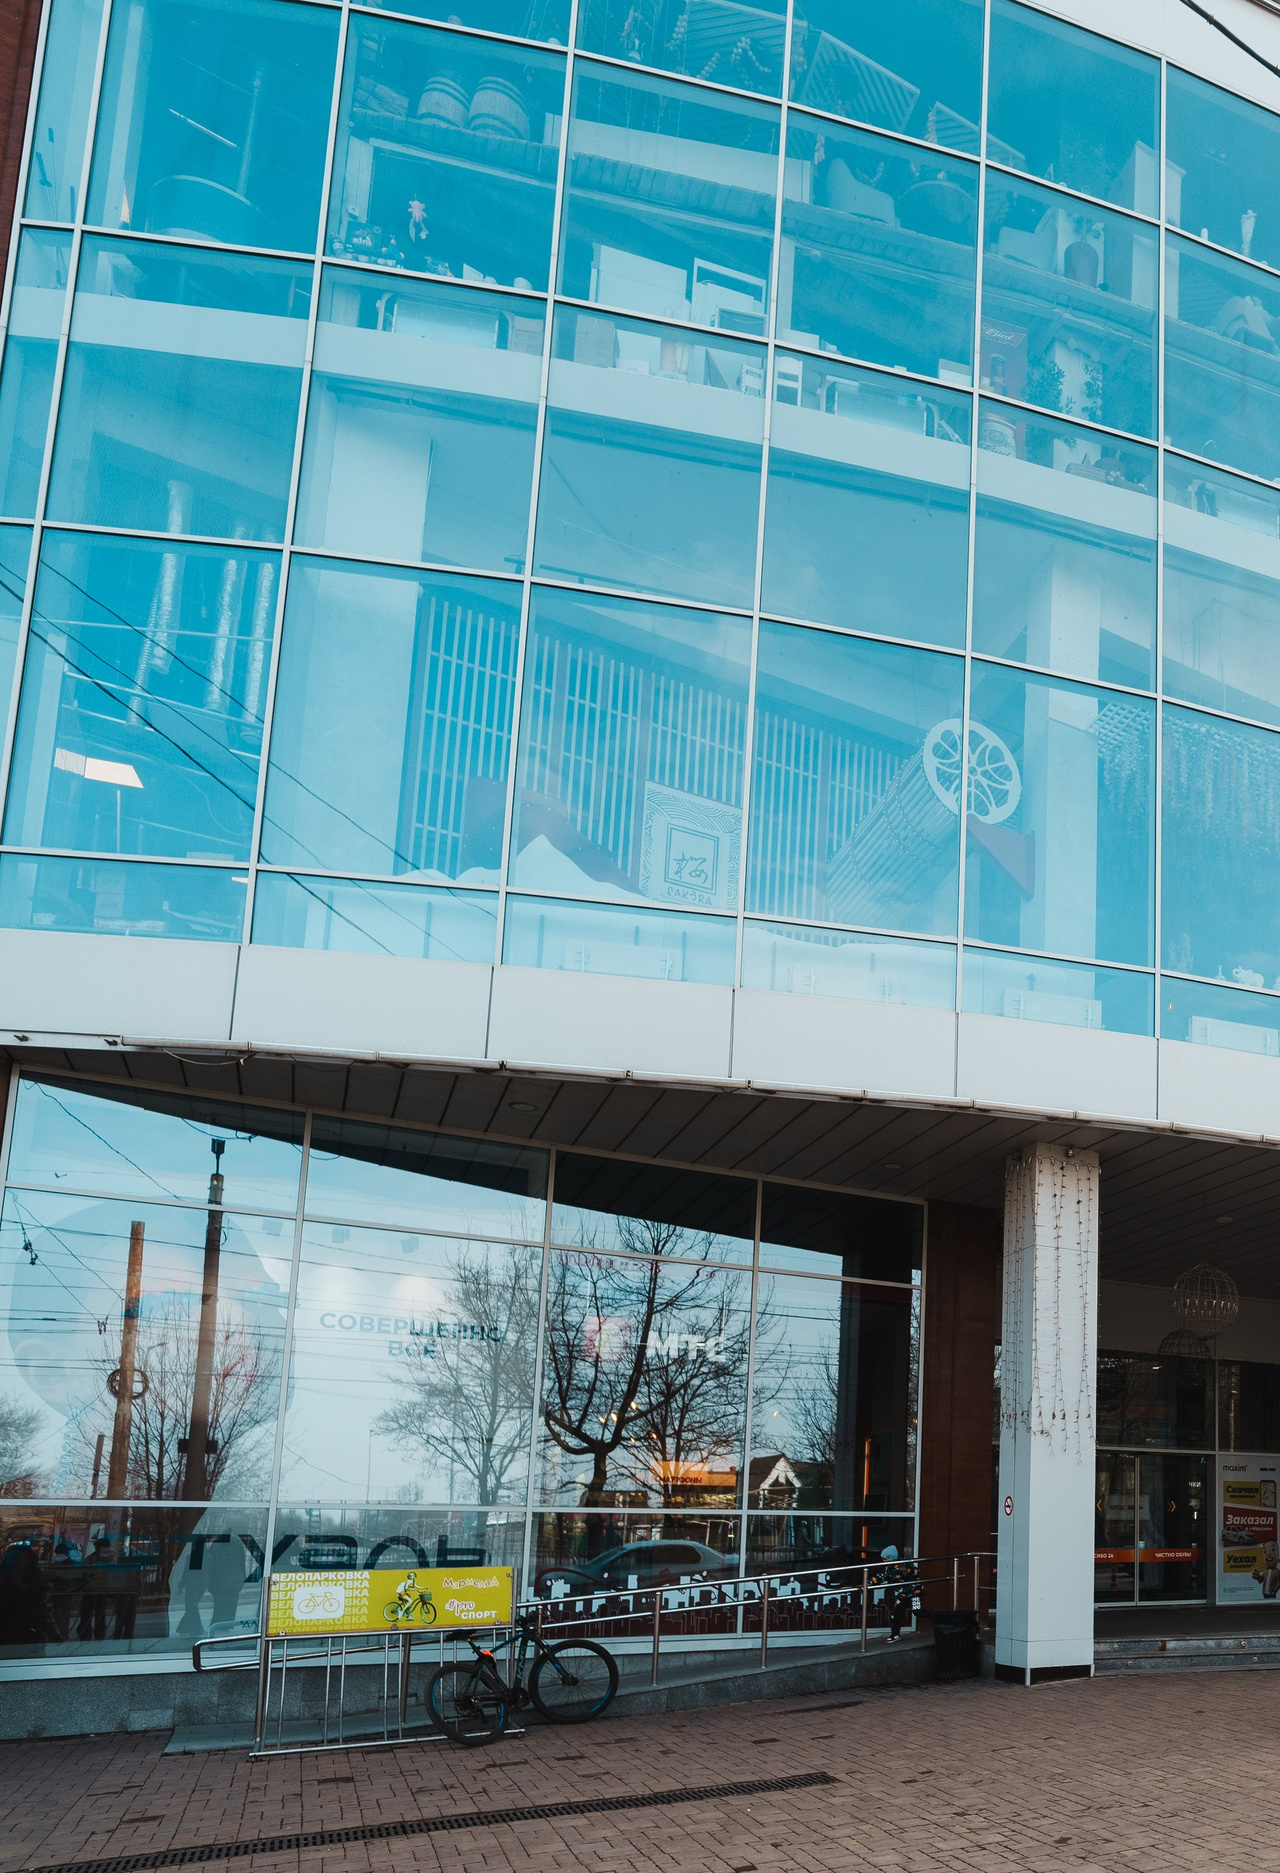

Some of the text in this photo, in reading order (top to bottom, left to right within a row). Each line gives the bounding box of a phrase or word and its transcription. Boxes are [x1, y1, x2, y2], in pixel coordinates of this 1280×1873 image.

[982, 326, 1014, 341] Bud
[319, 1312, 506, 1343] СОВЕРШЕННО
[645, 1330, 727, 1363] МТС
[1222, 1464, 1247, 1472] maxim
[1225, 1485, 1259, 1494] Скачал
[1225, 1514, 1274, 1525] Заказал
[1226, 1554, 1257, 1564] Уехал
[272, 1571, 371, 1582] ВЕЛОПАРКОВКА
[445, 1598, 476, 1617] #pro
[461, 1610, 498, 1620] СПОРТ
